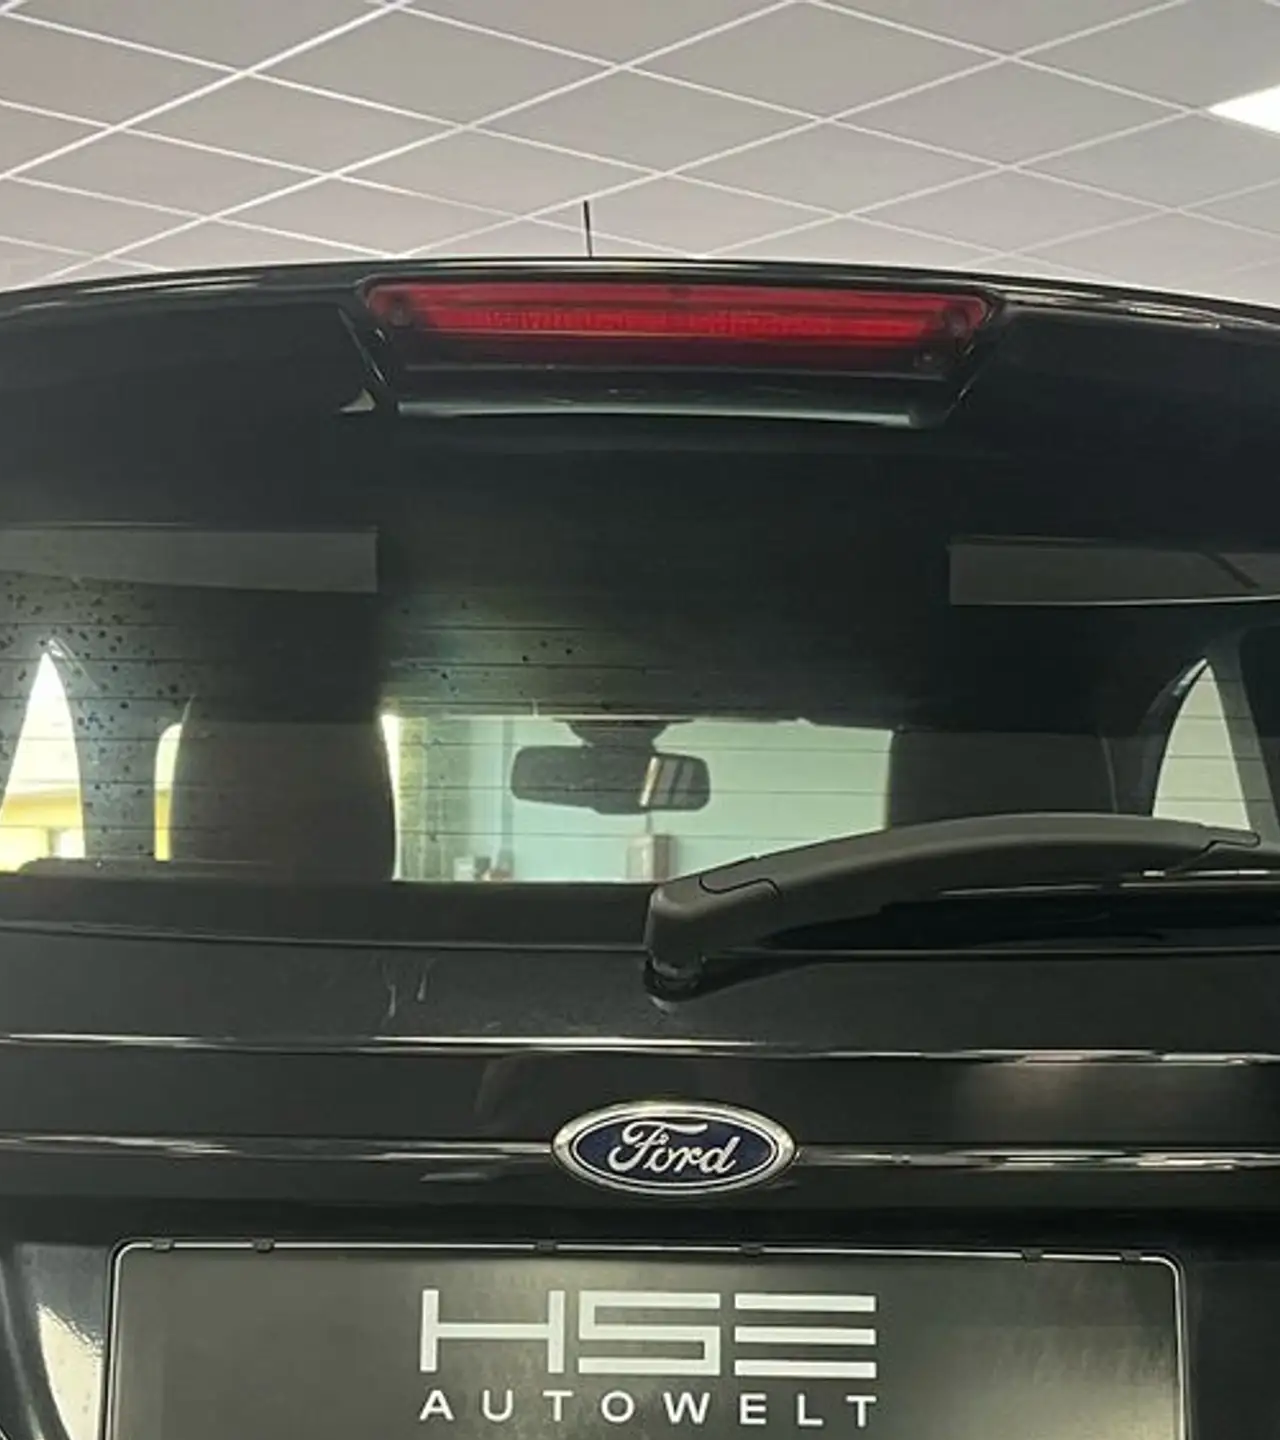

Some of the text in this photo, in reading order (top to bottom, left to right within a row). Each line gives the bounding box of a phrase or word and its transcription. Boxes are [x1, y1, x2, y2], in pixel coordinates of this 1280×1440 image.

[608, 1121, 741, 1174] Ford
[420, 1290, 876, 1378] HSE
[420, 1390, 877, 1428] AUTOWELT
